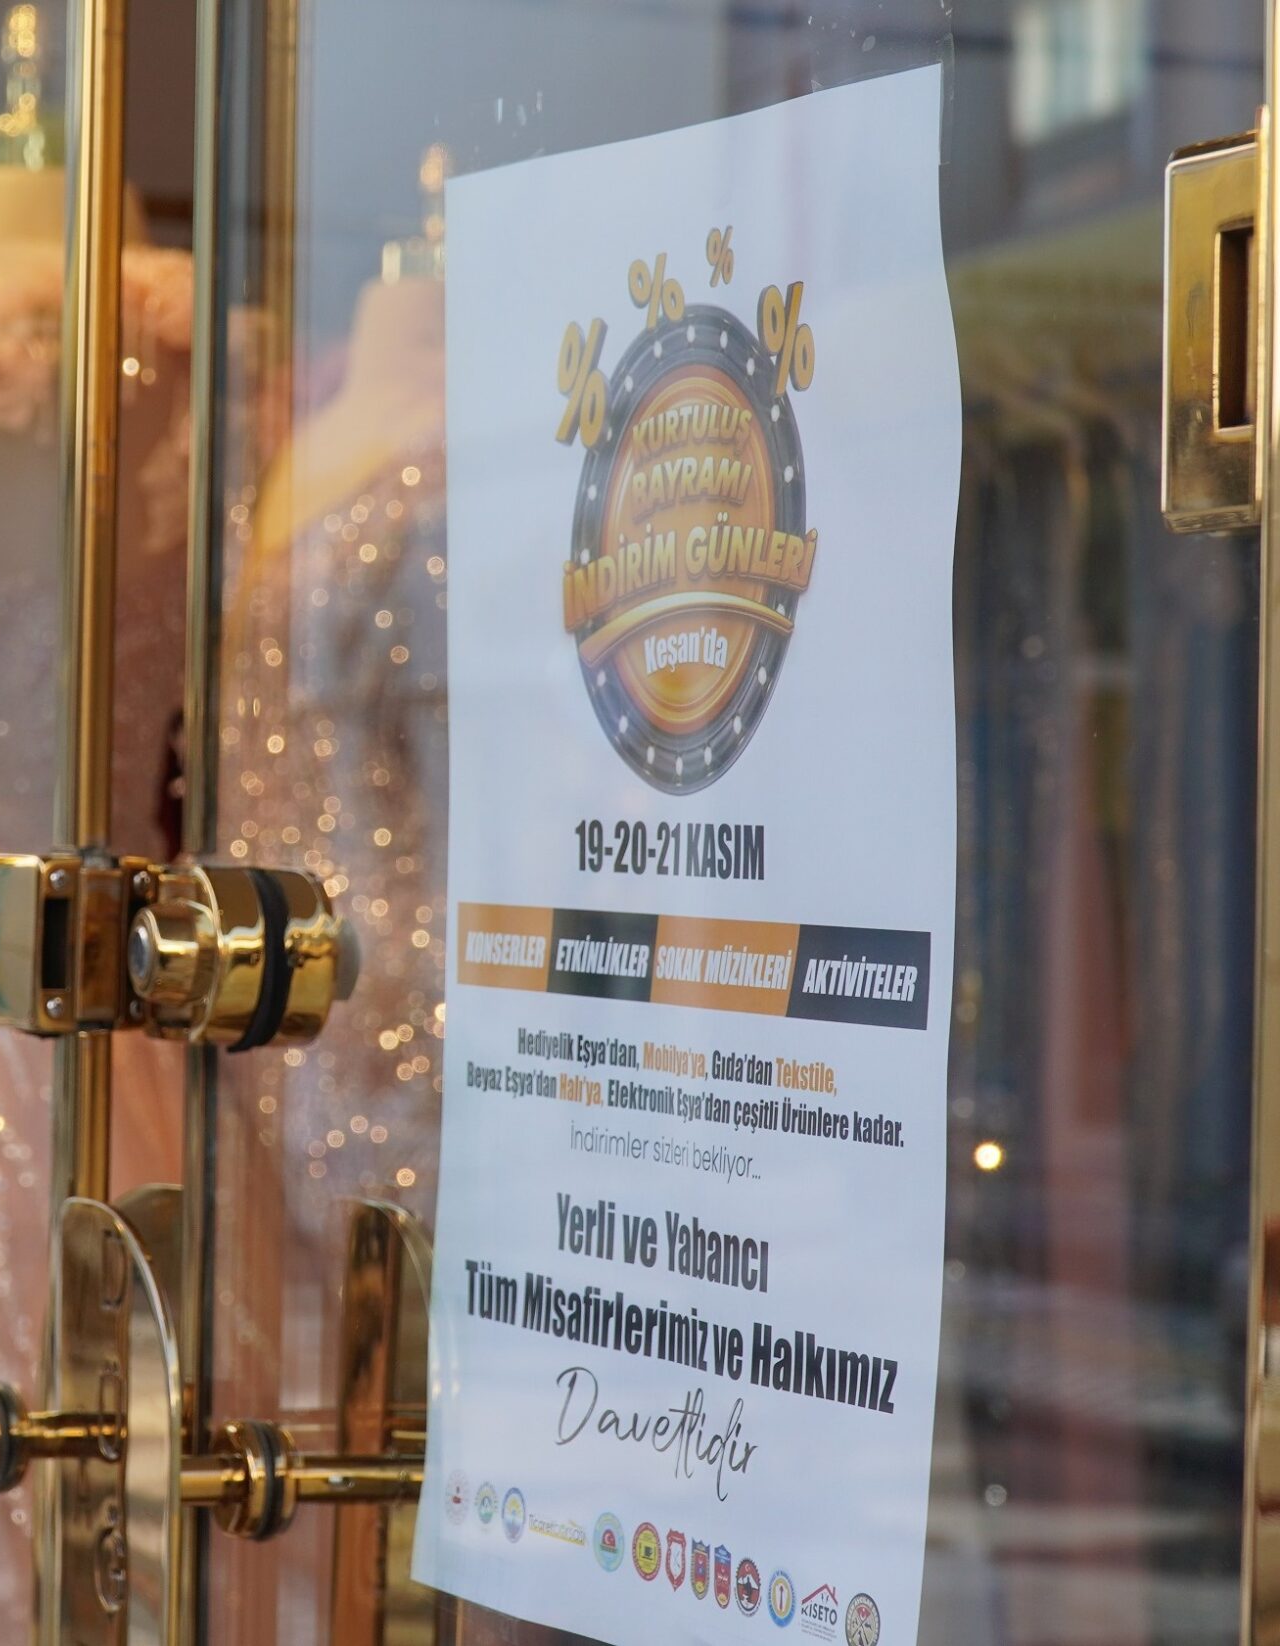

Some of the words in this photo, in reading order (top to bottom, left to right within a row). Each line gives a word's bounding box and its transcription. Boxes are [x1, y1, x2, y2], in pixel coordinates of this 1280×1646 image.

[632, 403, 753, 453] KURTULUŞ
[631, 456, 752, 513] BAYRAMI
[563, 522, 677, 632] İNDİRİM
[684, 511, 818, 592] GÜNLERİ
[644, 626, 728, 673] Keşan'da
[575, 819, 681, 876] 19-20-21
[685, 822, 765, 881] KASIM
[465, 931, 547, 968] KONSERLER
[555, 934, 650, 978] ETKİNLİKLER
[656, 945, 705, 983] SOKAK
[704, 945, 792, 990] MÜZİKLERİ
[802, 954, 918, 1002] AKTİVİTELER
[518, 1027, 574, 1061] Hediyelik
[577, 1034, 640, 1069] Eşya'dan,
[642, 1041, 709, 1081] Mobilya'ya,
[711, 1049, 773, 1087] Gıda'dan
[775, 1057, 838, 1097] Tekstile,
[467, 1061, 502, 1092] Beyaz
[505, 1065, 557, 1099] Eşya'dan
[607, 1079, 675, 1115] Elektronik
[677, 1088, 730, 1125] Eşya'dan
[733, 1100, 779, 1134] çeşitli
[781, 1097, 849, 1141] Ürünlere
[852, 1111, 904, 1148] kadar.
[570, 1120, 650, 1160] İndirimler
[652, 1136, 690, 1167] sizleri
[692, 1141, 761, 1184] bekliyor...
[557, 1192, 616, 1261] Yerli
[622, 1214, 658, 1268] ve
[665, 1210, 769, 1293] Yabancı
[465, 1259, 518, 1325] Tüm
[522, 1272, 708, 1372] Misafirlerimiz
[713, 1324, 744, 1381] ve
[750, 1322, 898, 1414] Halkımız
[555, 1366, 759, 1502] Davetlidir
